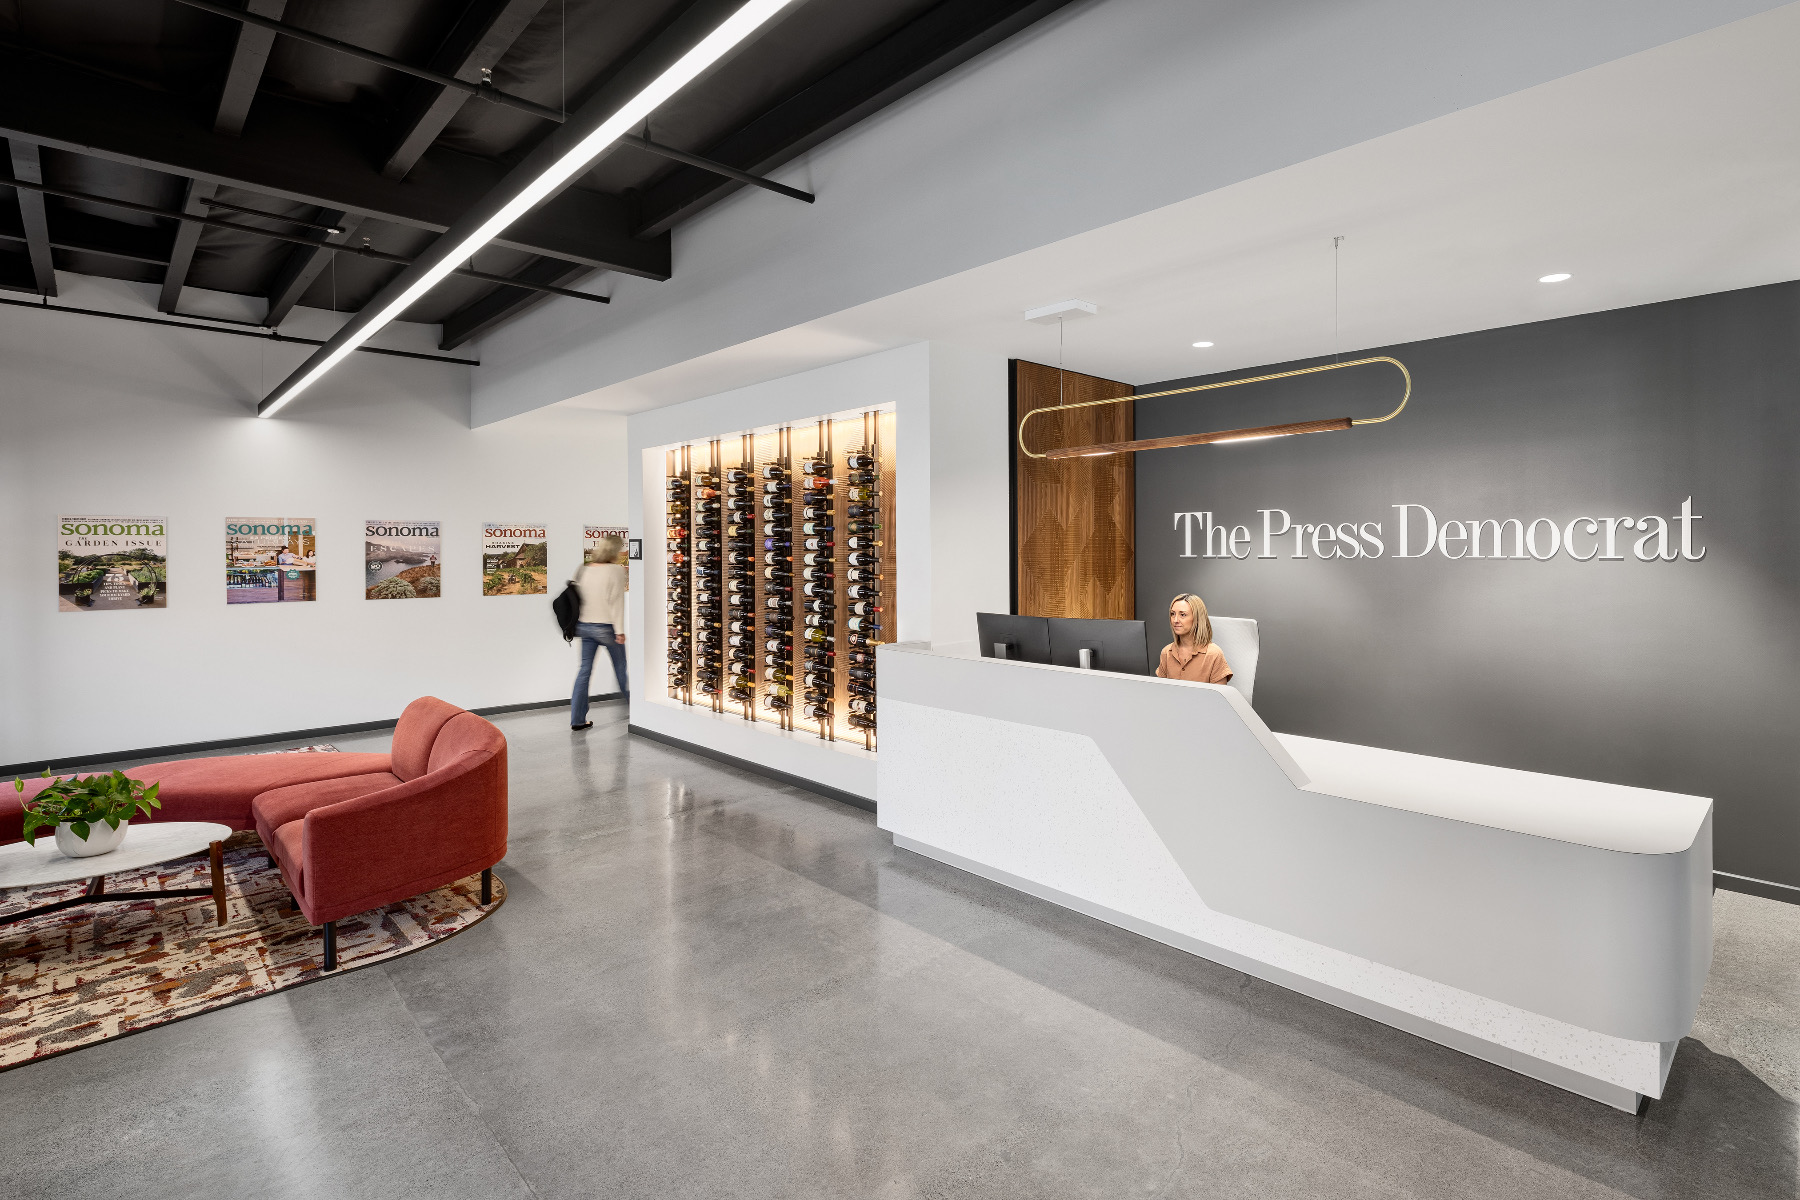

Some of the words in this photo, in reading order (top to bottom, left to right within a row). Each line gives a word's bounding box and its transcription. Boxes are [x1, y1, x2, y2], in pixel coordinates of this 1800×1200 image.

[61, 524, 165, 535] sonoma
[226, 524, 313, 535] sonoma
[365, 526, 439, 536] sonoma
[484, 528, 546, 538] sonoma
[1174, 511, 1251, 559] The
[1256, 508, 1385, 560] Press
[1391, 495, 1707, 562] Democrat
